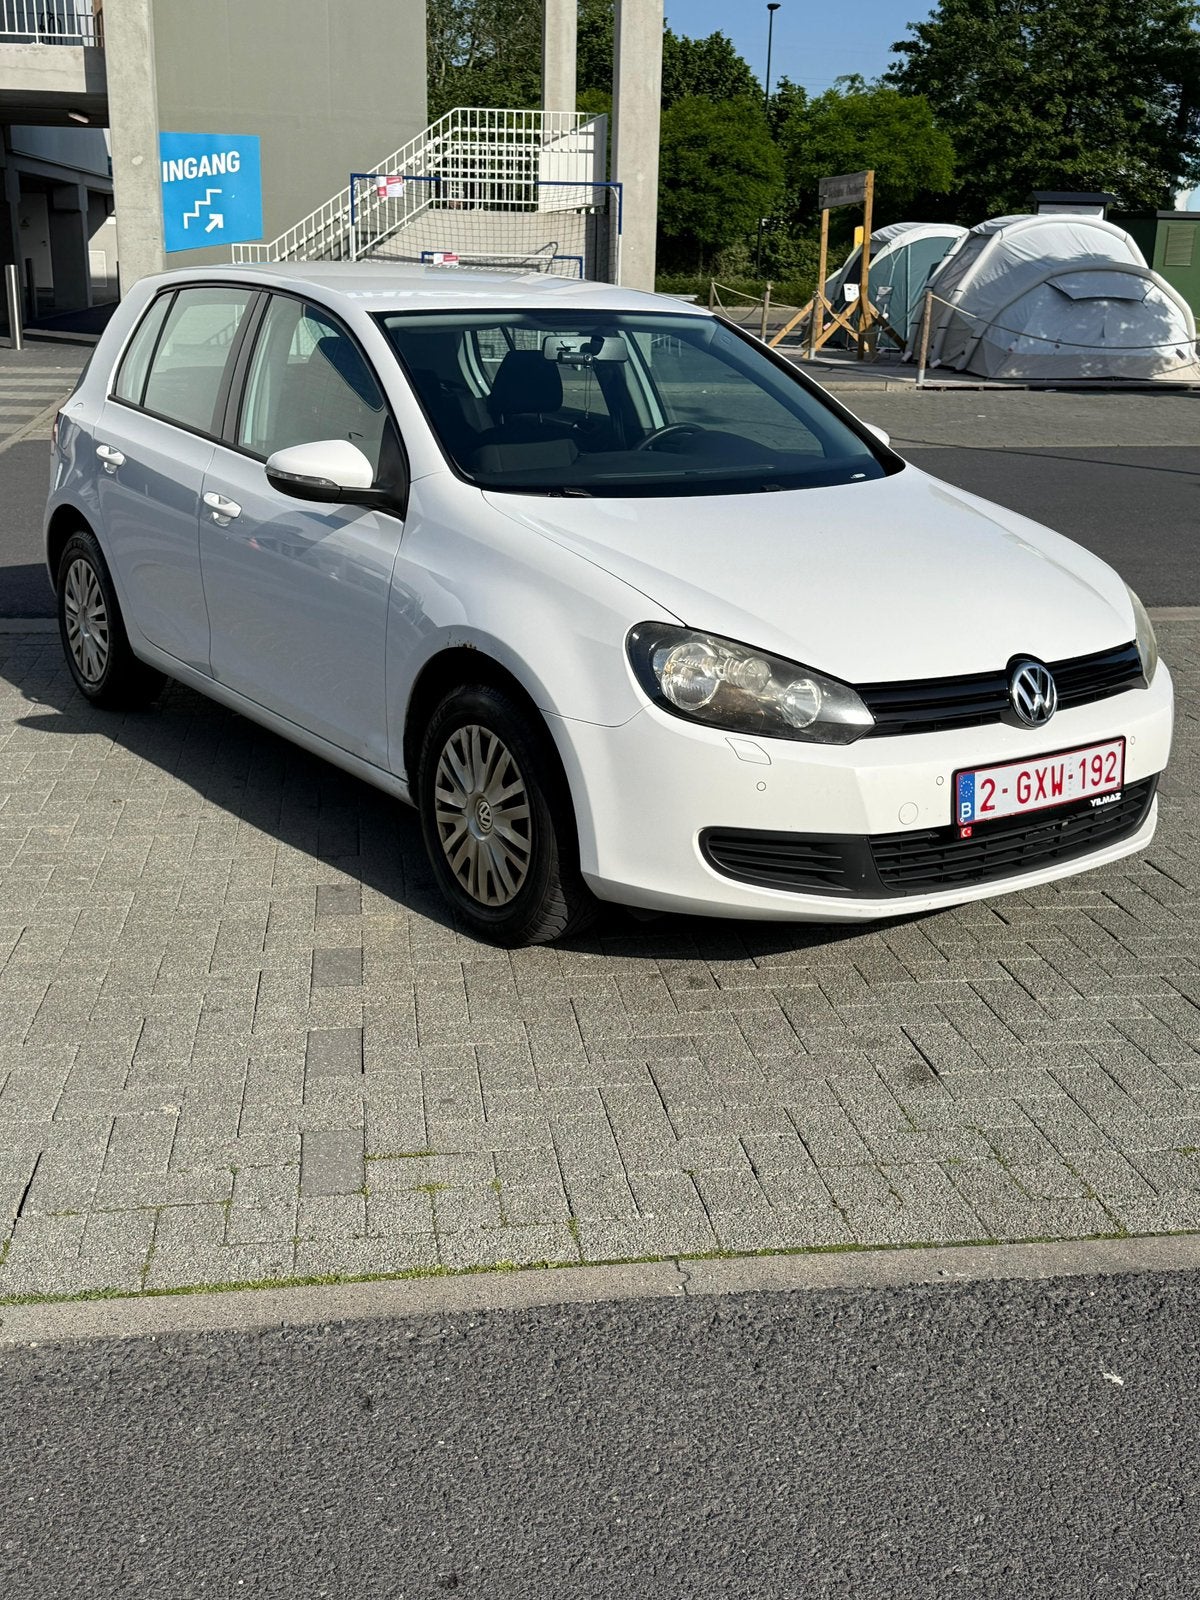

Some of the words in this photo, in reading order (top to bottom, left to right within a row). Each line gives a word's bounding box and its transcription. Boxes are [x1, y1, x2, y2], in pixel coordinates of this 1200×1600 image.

[162, 151, 240, 183] INGANG
[980, 751, 1117, 812] 2-GXW-192
[961, 802, 973, 818] B
[1090, 792, 1122, 807] YILMAZ
